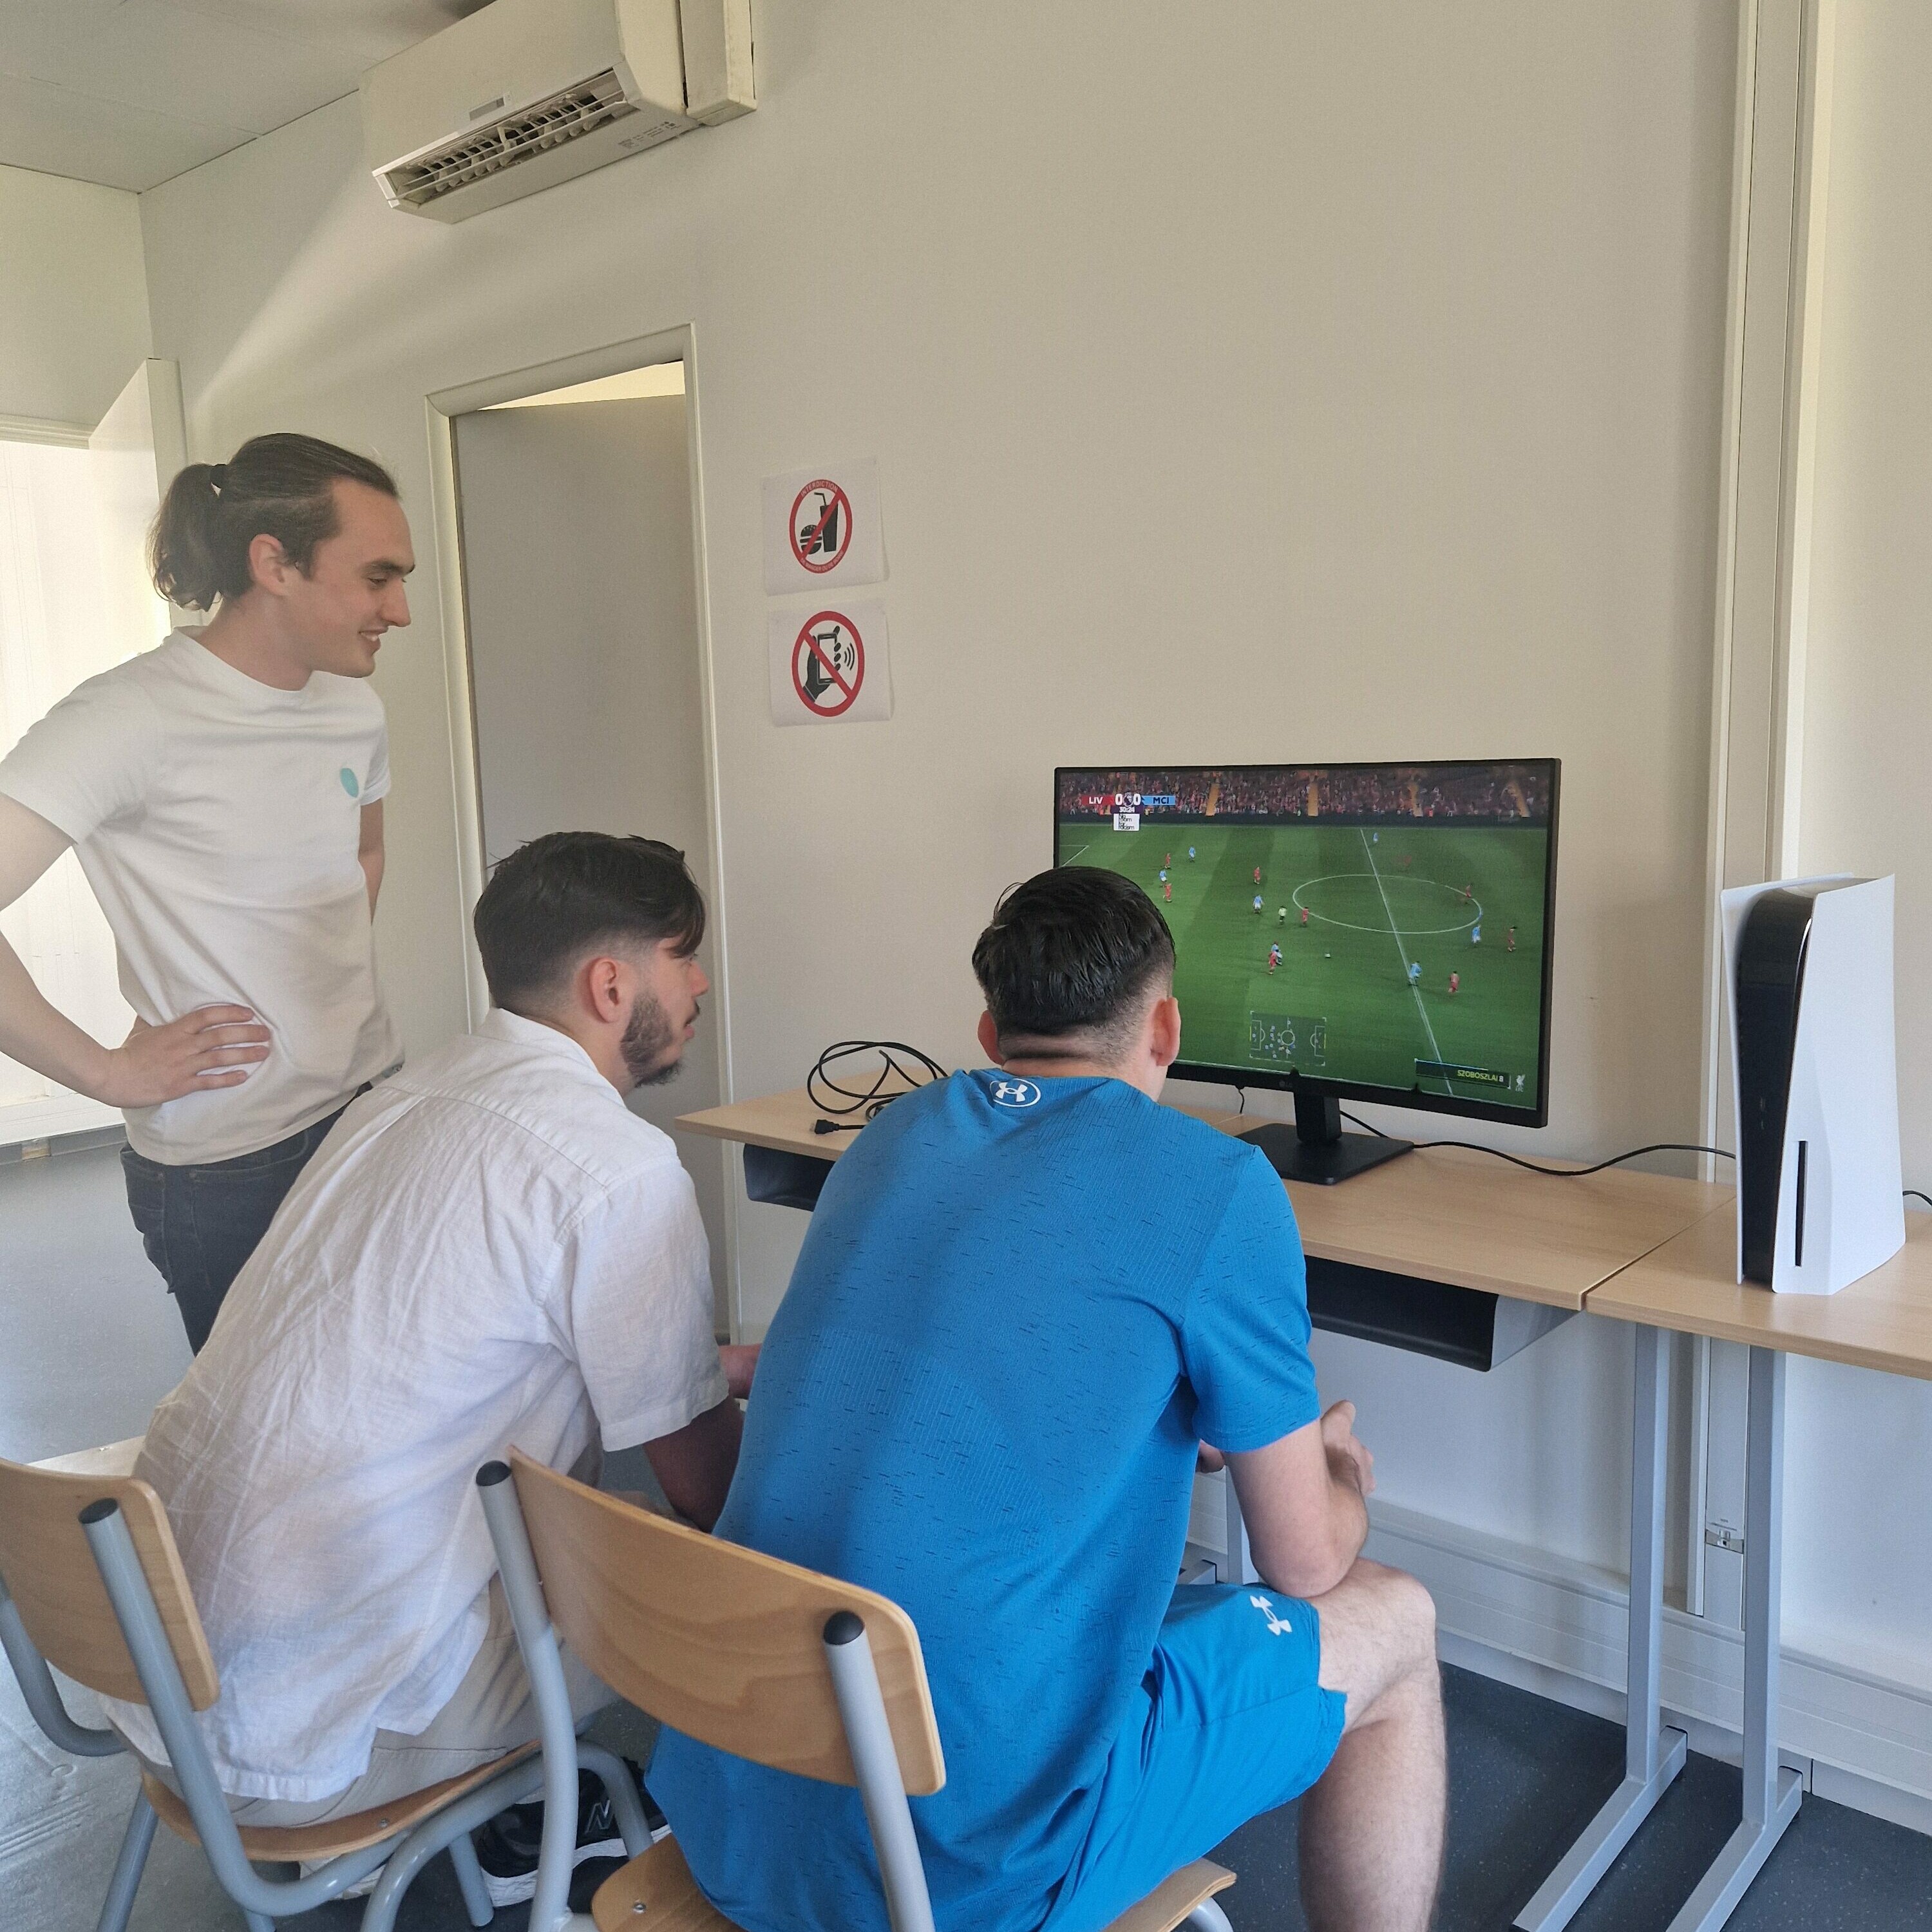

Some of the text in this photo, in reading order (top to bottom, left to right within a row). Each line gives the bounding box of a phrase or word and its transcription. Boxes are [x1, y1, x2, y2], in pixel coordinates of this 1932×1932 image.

[800, 480, 838, 497] INTERDICTION
[1115, 793, 1122, 805] 0
[1133, 793, 1141, 805] 0
[1457, 1070, 1498, 1081] SZOBOSZLAI
